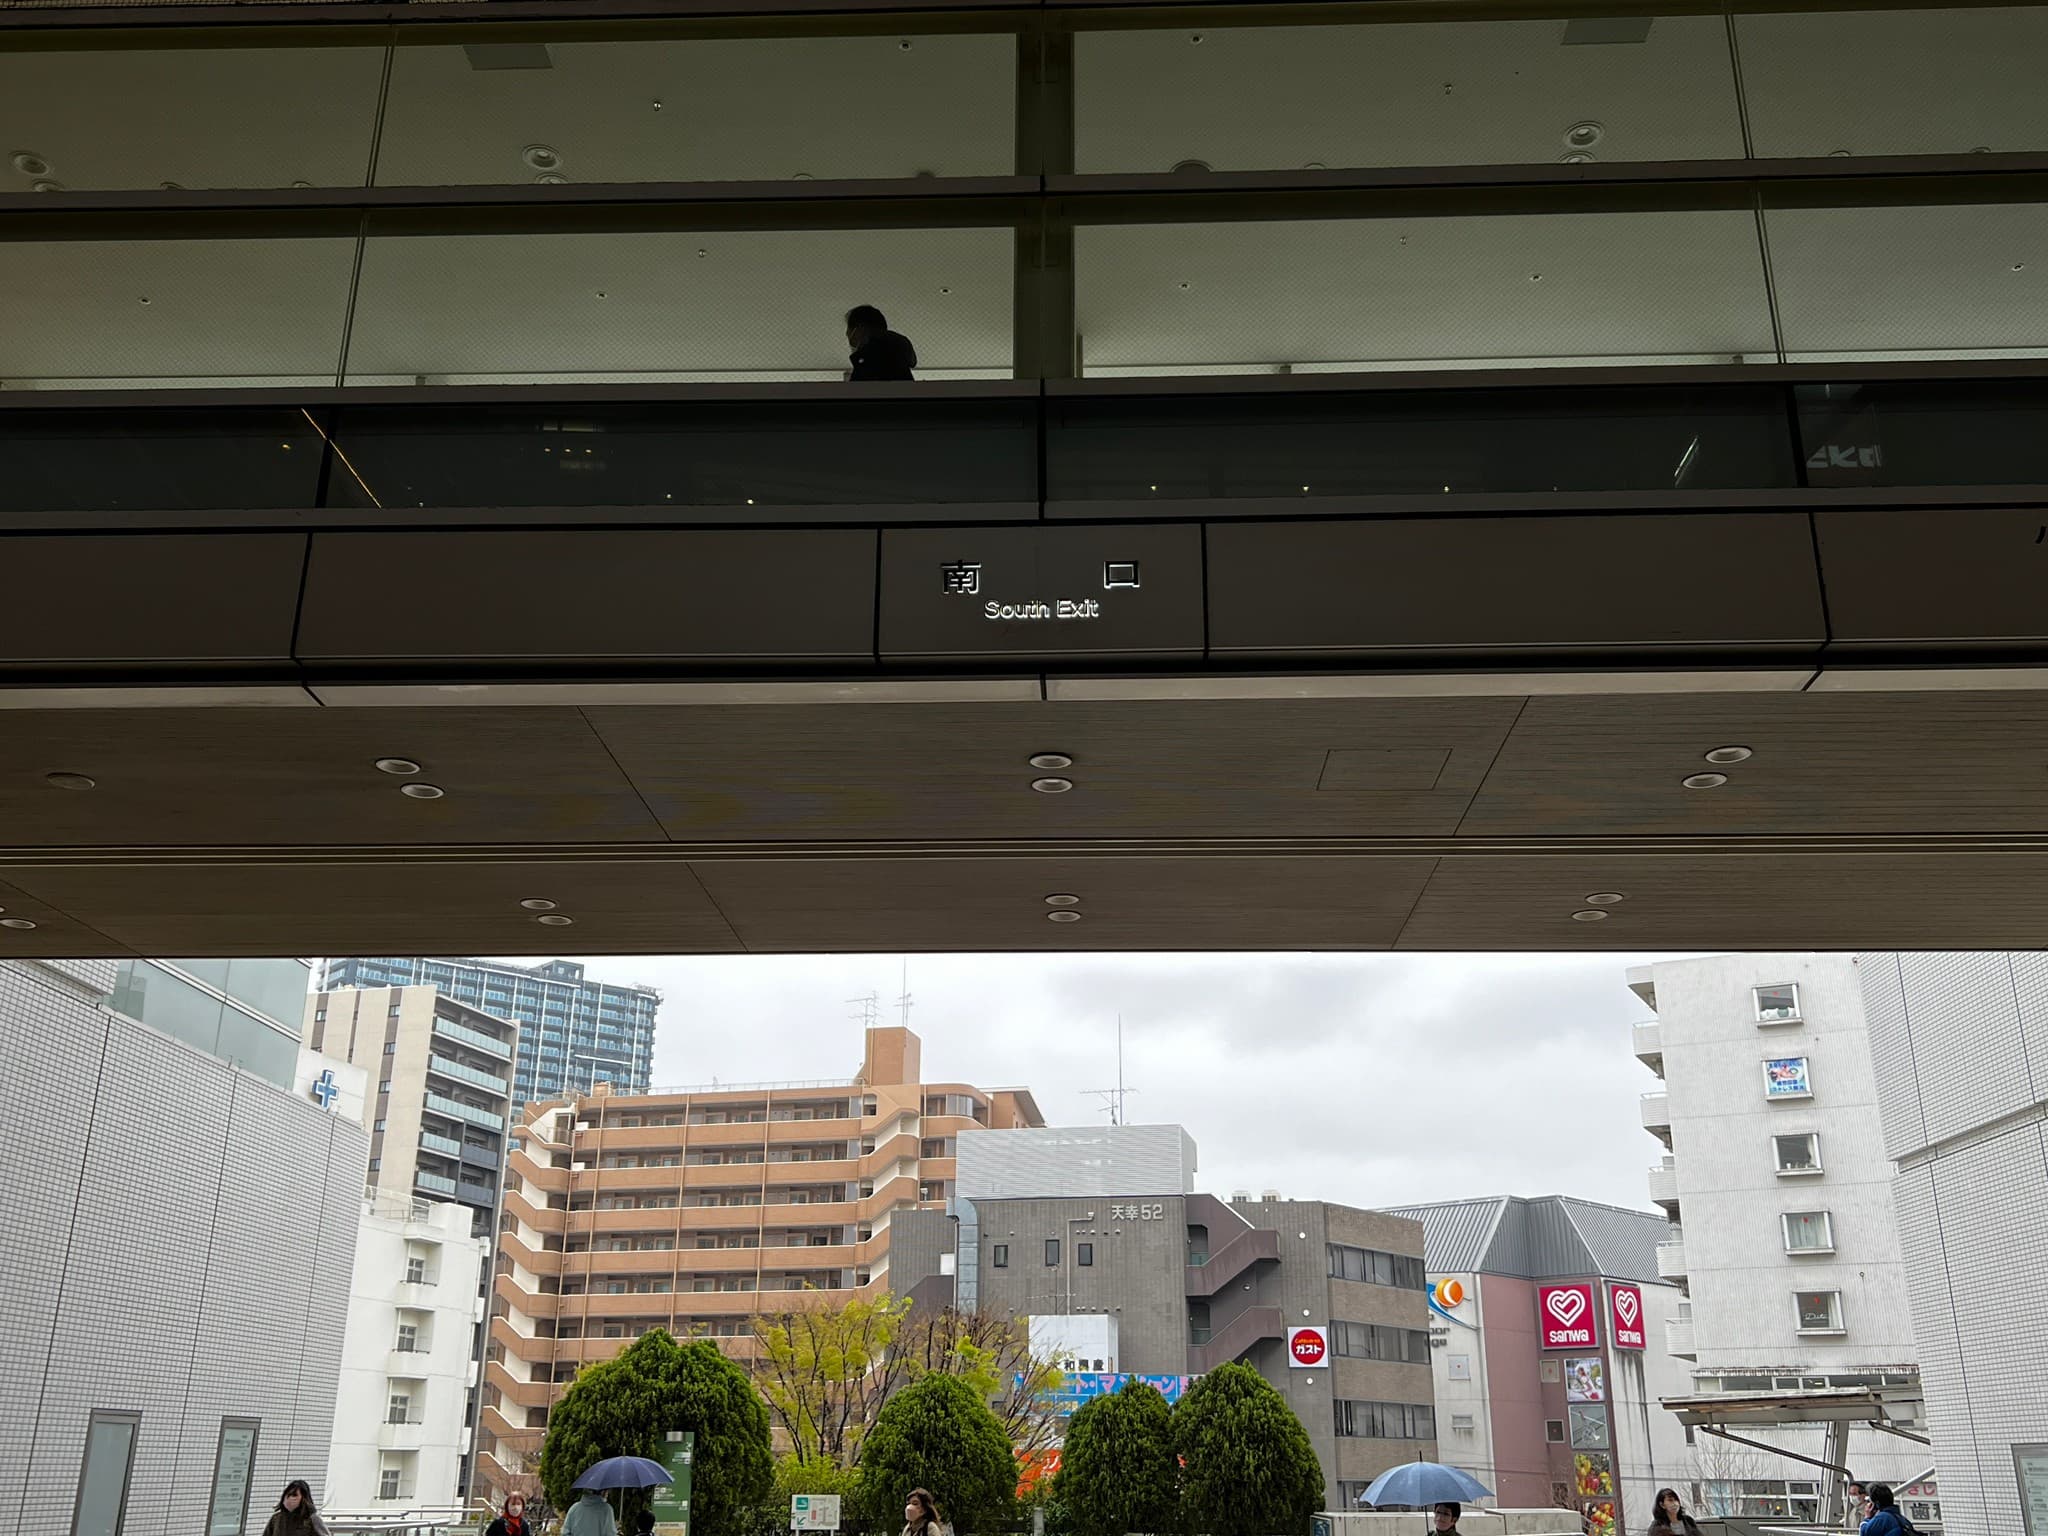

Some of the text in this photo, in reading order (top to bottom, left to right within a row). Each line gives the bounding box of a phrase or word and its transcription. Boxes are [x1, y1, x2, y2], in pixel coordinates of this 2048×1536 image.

[941, 559, 1141, 594] 南口
[984, 599, 1099, 618] South Exit
[1111, 1204, 1164, 1221] 天幸52
[1549, 1329, 1589, 1343] sanwa
[1618, 1330, 1641, 1344] sanwa
[1295, 1344, 1322, 1355] ガスト
